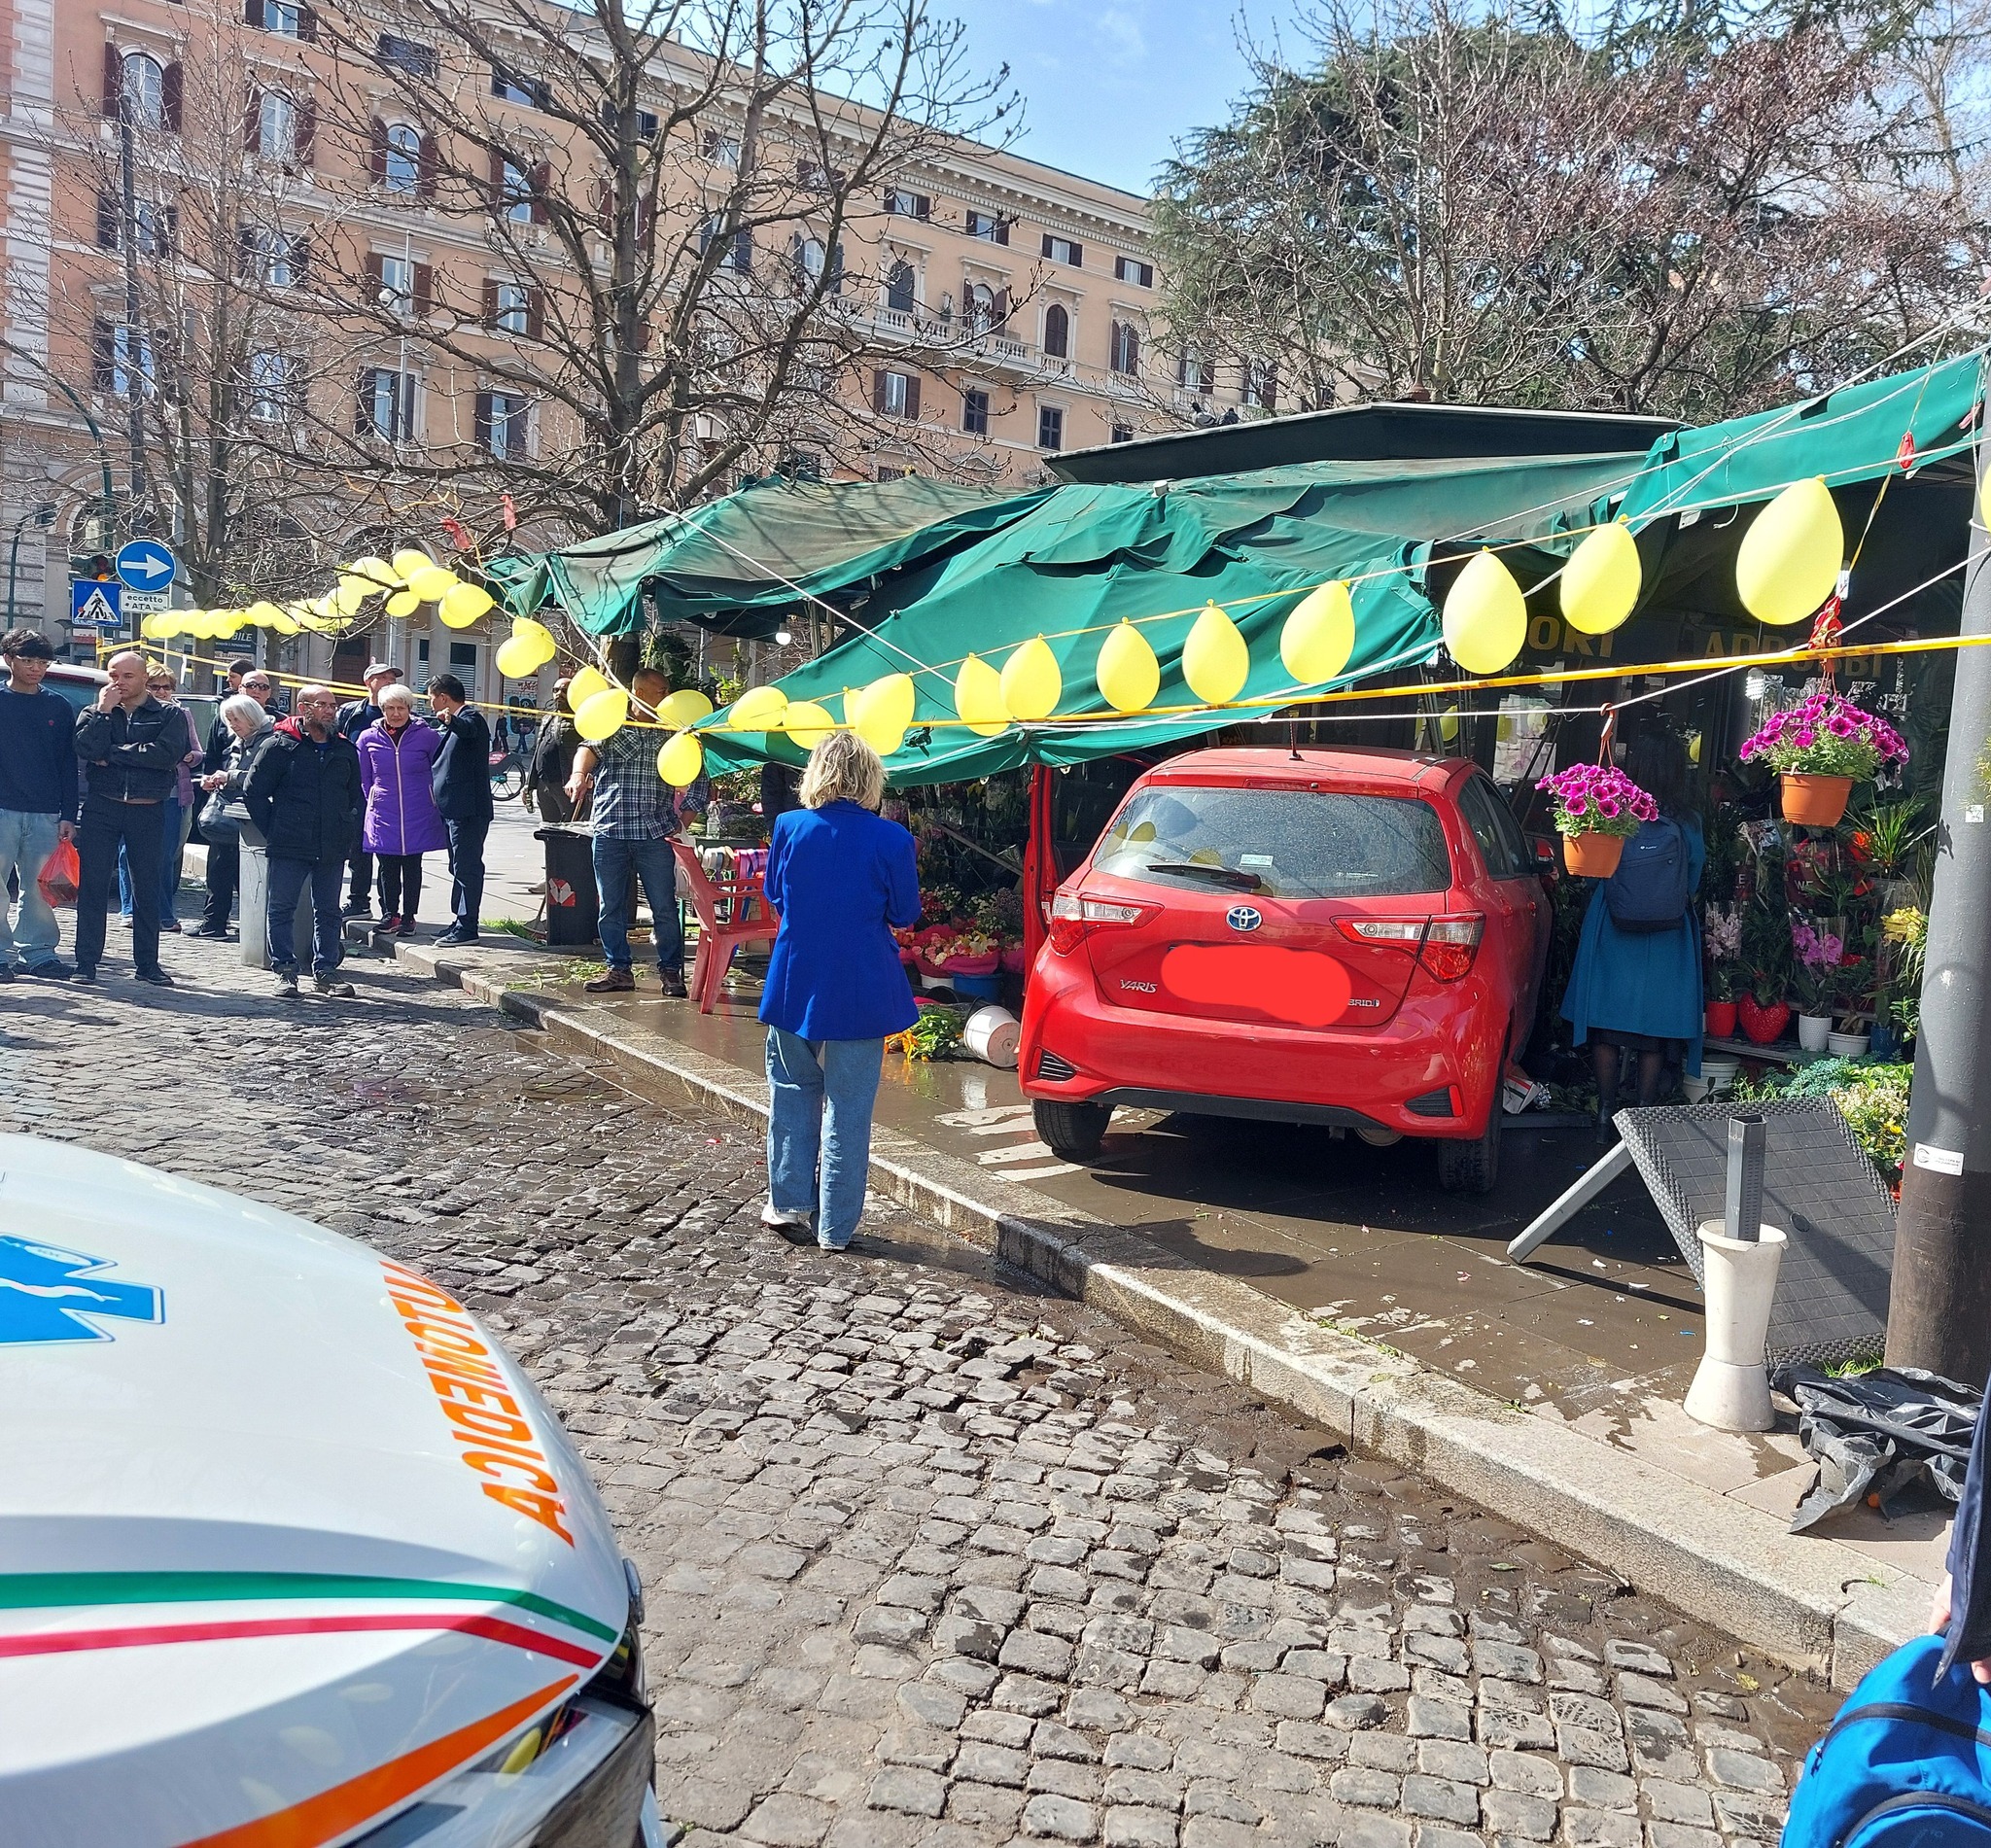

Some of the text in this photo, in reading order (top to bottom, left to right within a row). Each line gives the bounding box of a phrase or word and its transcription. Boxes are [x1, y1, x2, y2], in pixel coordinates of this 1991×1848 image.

[126, 595, 163, 604] eccetto
[231, 632, 253, 642] BILE
[1704, 631, 1883, 678] ADDOBI
[1120, 979, 1158, 993] YARIS
[1347, 998, 1375, 1007] BRID
